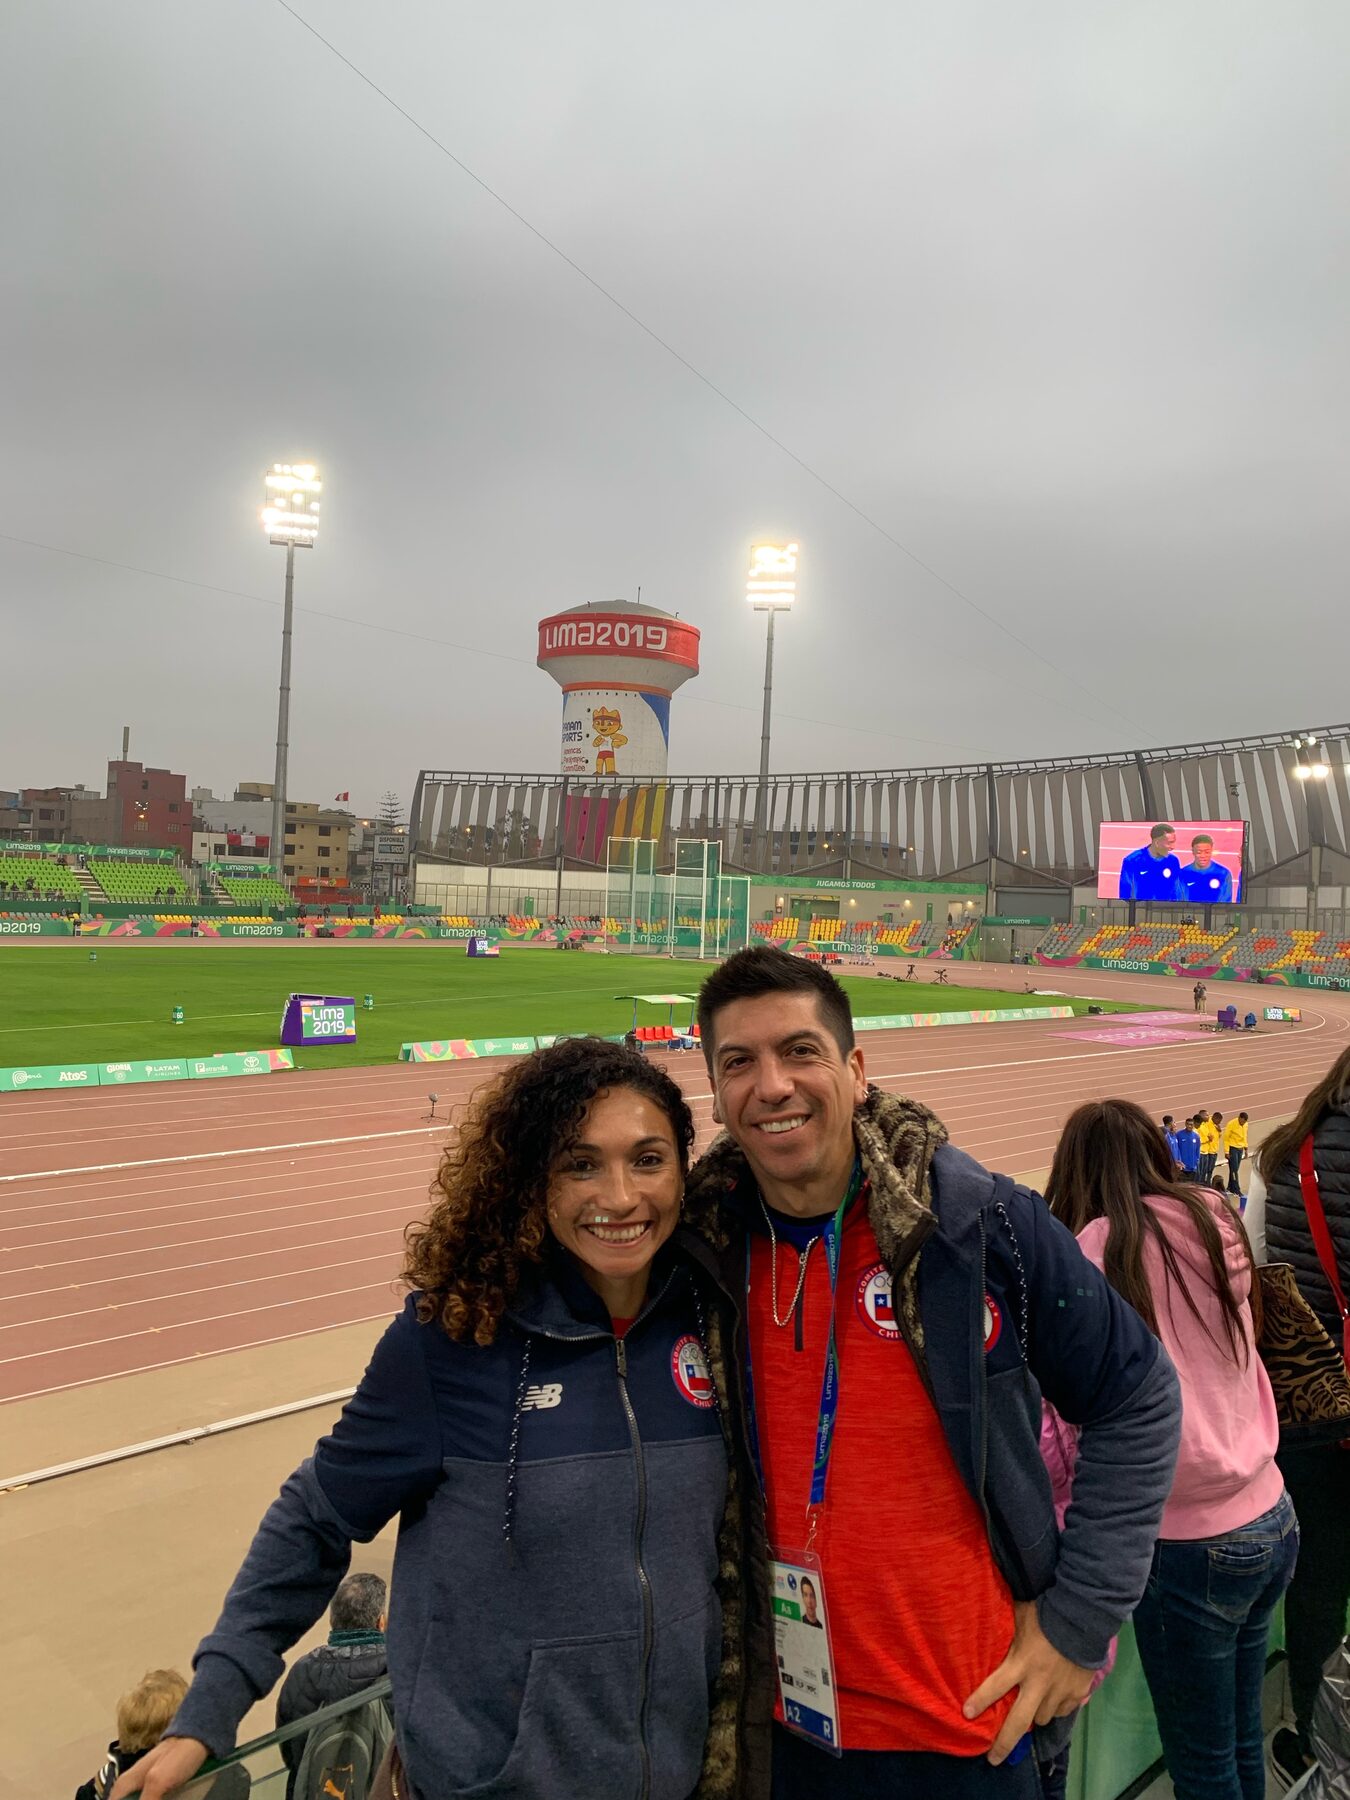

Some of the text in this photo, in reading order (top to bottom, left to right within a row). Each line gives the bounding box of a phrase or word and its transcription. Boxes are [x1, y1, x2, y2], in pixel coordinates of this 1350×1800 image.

[815, 880, 876, 889] JUGAMOS TODOS
[313, 1020, 345, 1034] 2019
[106, 1063, 132, 1073] GLORIA
[822, 1720, 831, 1739] R
